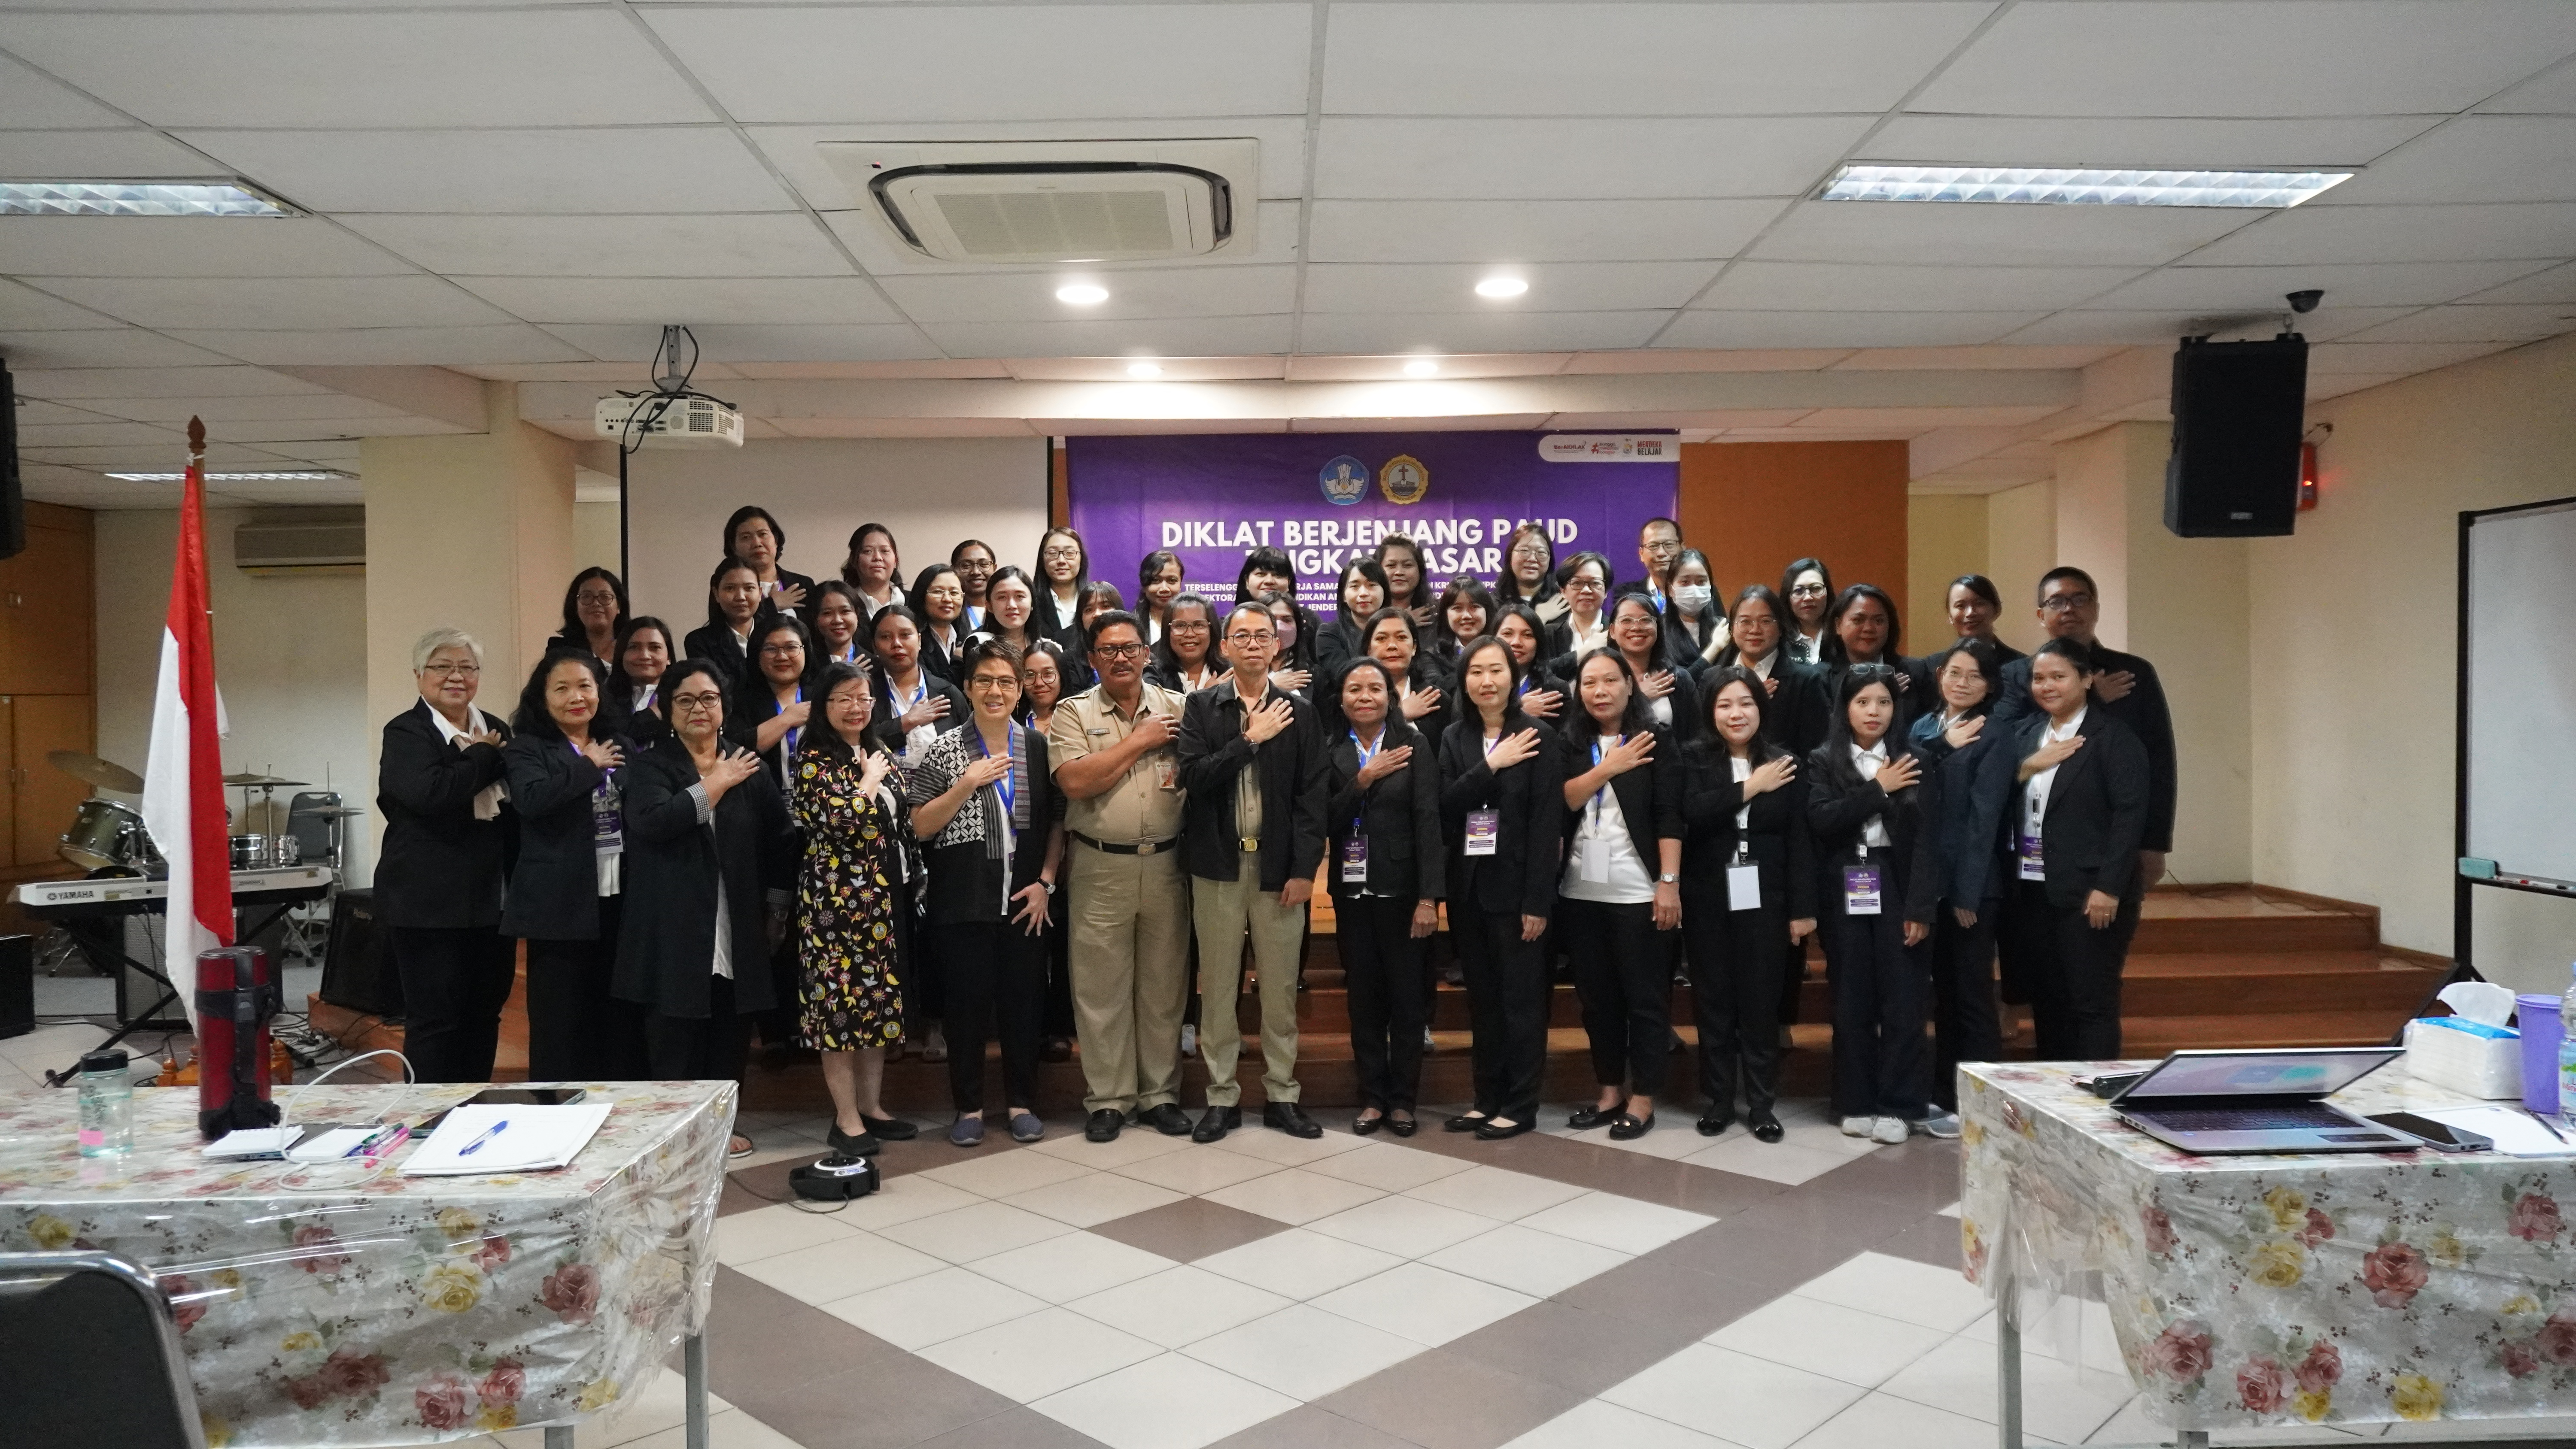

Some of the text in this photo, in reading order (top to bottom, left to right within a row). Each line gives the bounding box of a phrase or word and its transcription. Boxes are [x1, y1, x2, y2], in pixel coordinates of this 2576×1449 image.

[1162, 521, 1274, 547] DIKLAT
[1423, 547, 1503, 573] ASAR
[57, 890, 94, 900] YAMAHA
